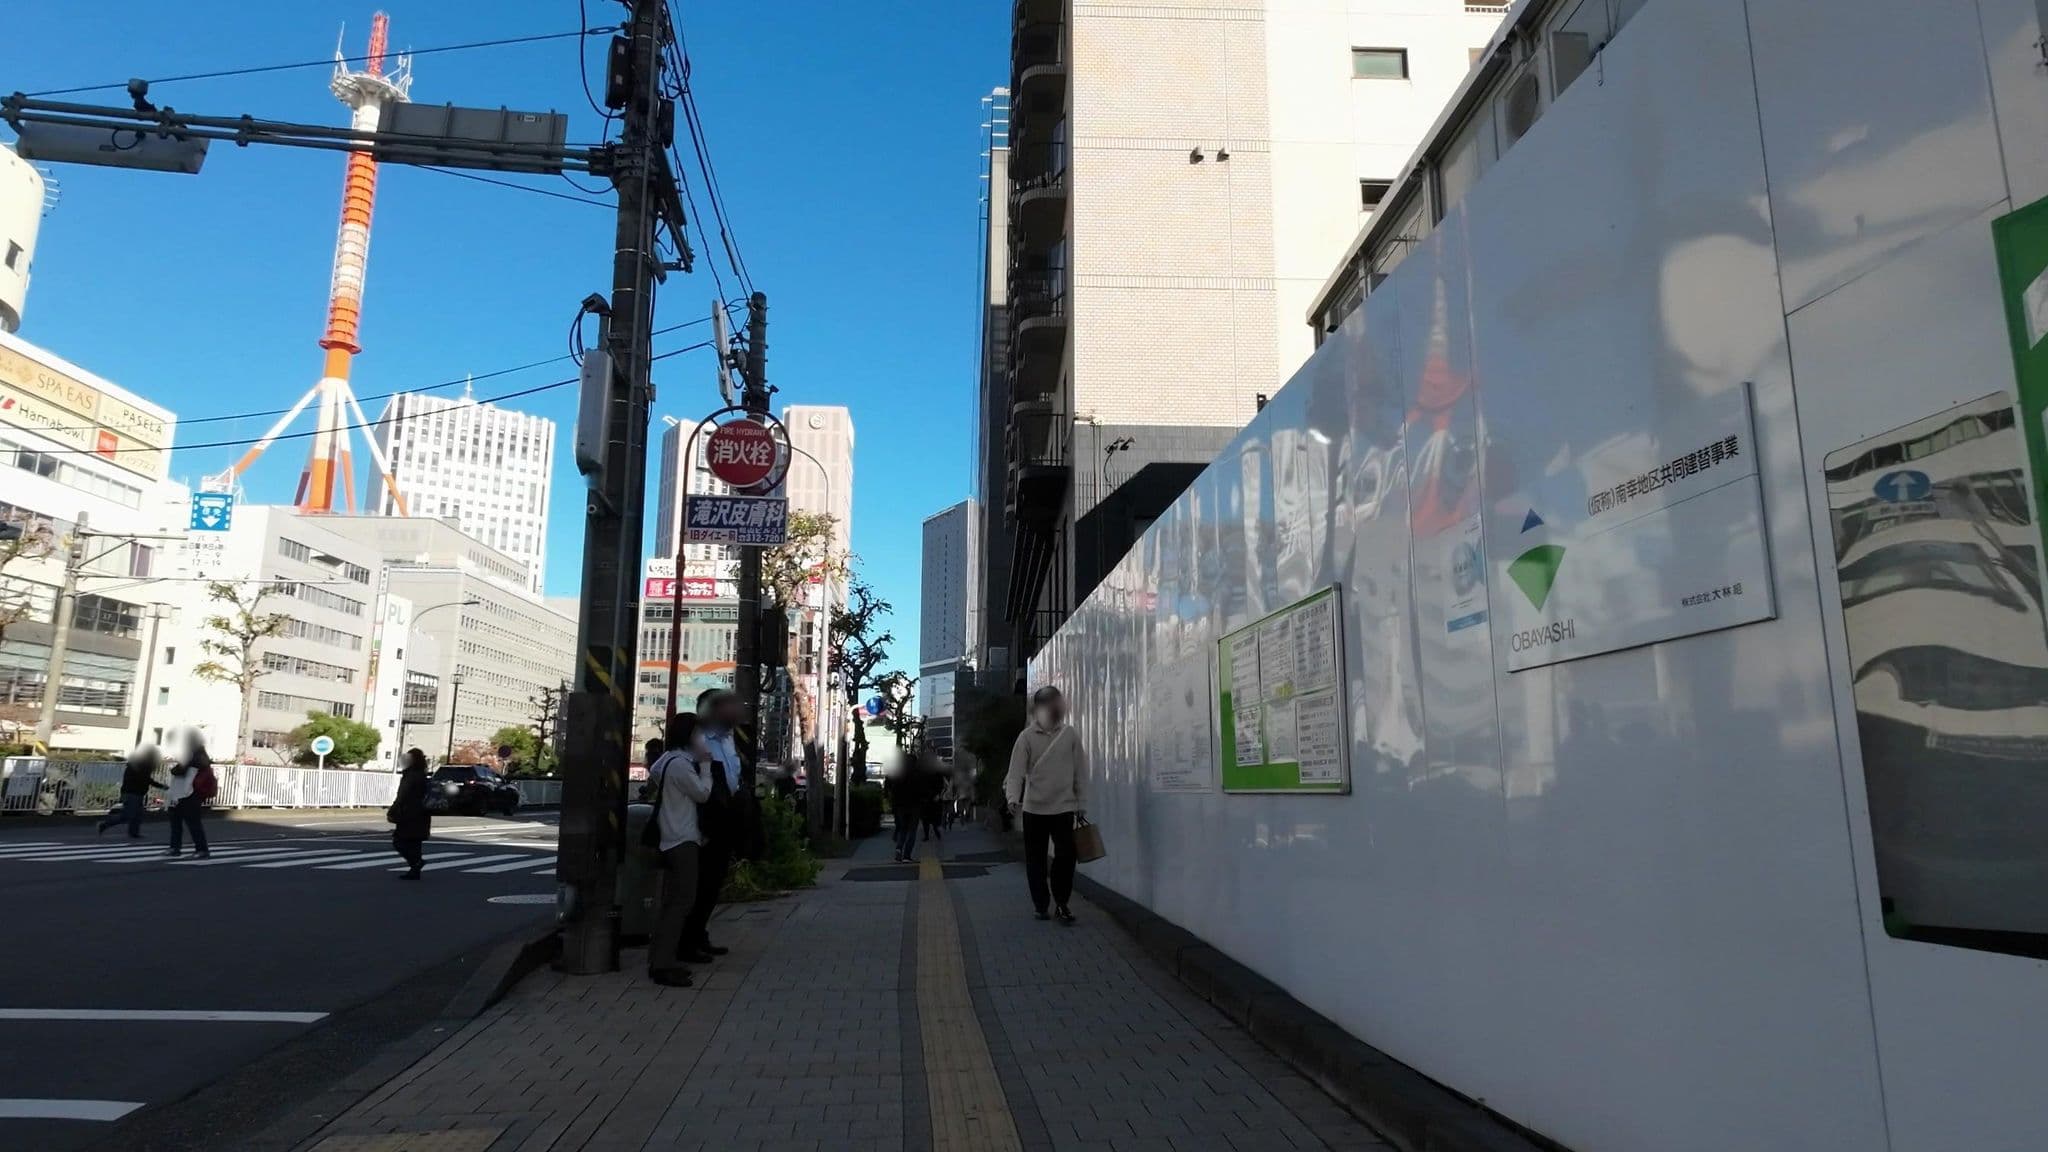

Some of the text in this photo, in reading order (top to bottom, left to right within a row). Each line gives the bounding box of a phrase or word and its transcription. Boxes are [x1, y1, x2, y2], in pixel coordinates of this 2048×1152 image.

[37, 373, 93, 410] SPA EAS
[18, 403, 86, 442] Hamabowl
[123, 408, 162, 434] PASELA
[720, 426, 766, 437] FIRE HYDRANT
[713, 438, 771, 466] 消火栓
[1587, 433, 1741, 517] (仮称)南幸地区共同建替事業
[691, 499, 785, 528] 滝沢皮膚科
[1511, 618, 1577, 654] OBAYASHI
